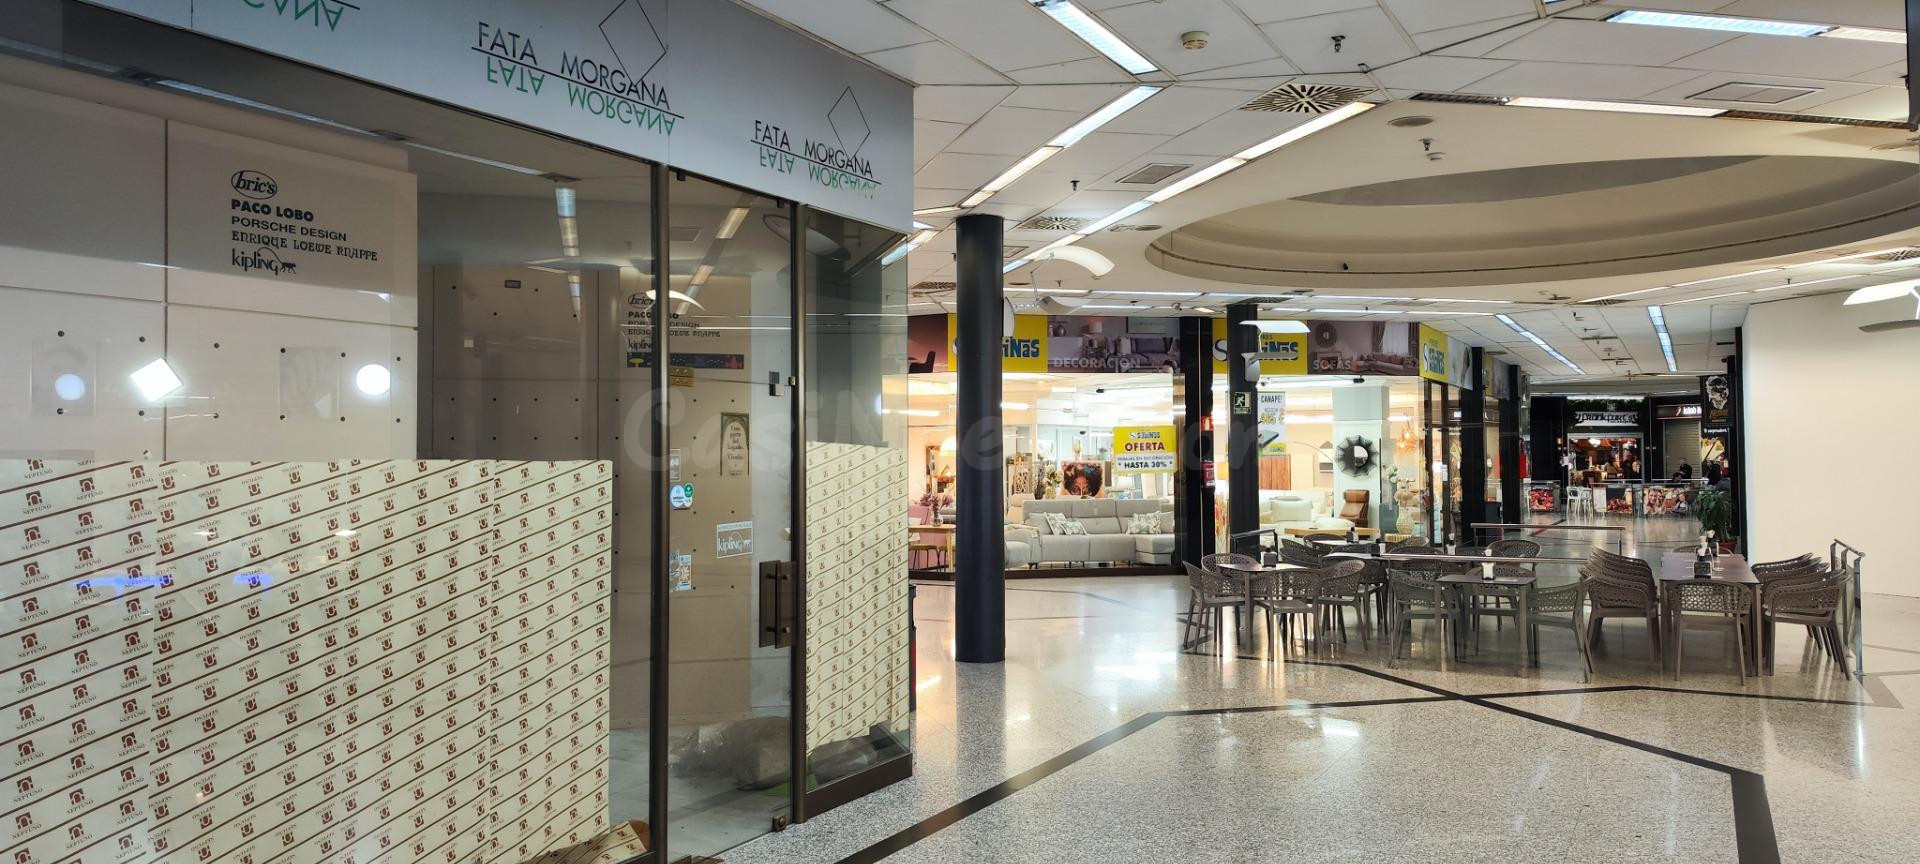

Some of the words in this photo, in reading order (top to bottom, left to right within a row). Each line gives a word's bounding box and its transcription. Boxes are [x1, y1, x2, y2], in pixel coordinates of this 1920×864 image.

[478, 21, 538, 65] FATA
[560, 51, 670, 110] MORGANA
[755, 119, 791, 151] FATA
[804, 138, 873, 178] MORGANA
[235, 171, 276, 195] bric's
[231, 199, 272, 215] PACO
[276, 206, 314, 222] LOBO
[231, 215, 296, 234] PORSCHE
[301, 226, 347, 242] DESIGN
[231, 230, 288, 249] ENRIQUE
[293, 239, 332, 255] LOEWE
[231, 248, 279, 276] kipling
[1124, 442, 1165, 451] OFERTA
[1124, 461, 1149, 469] HASTA
